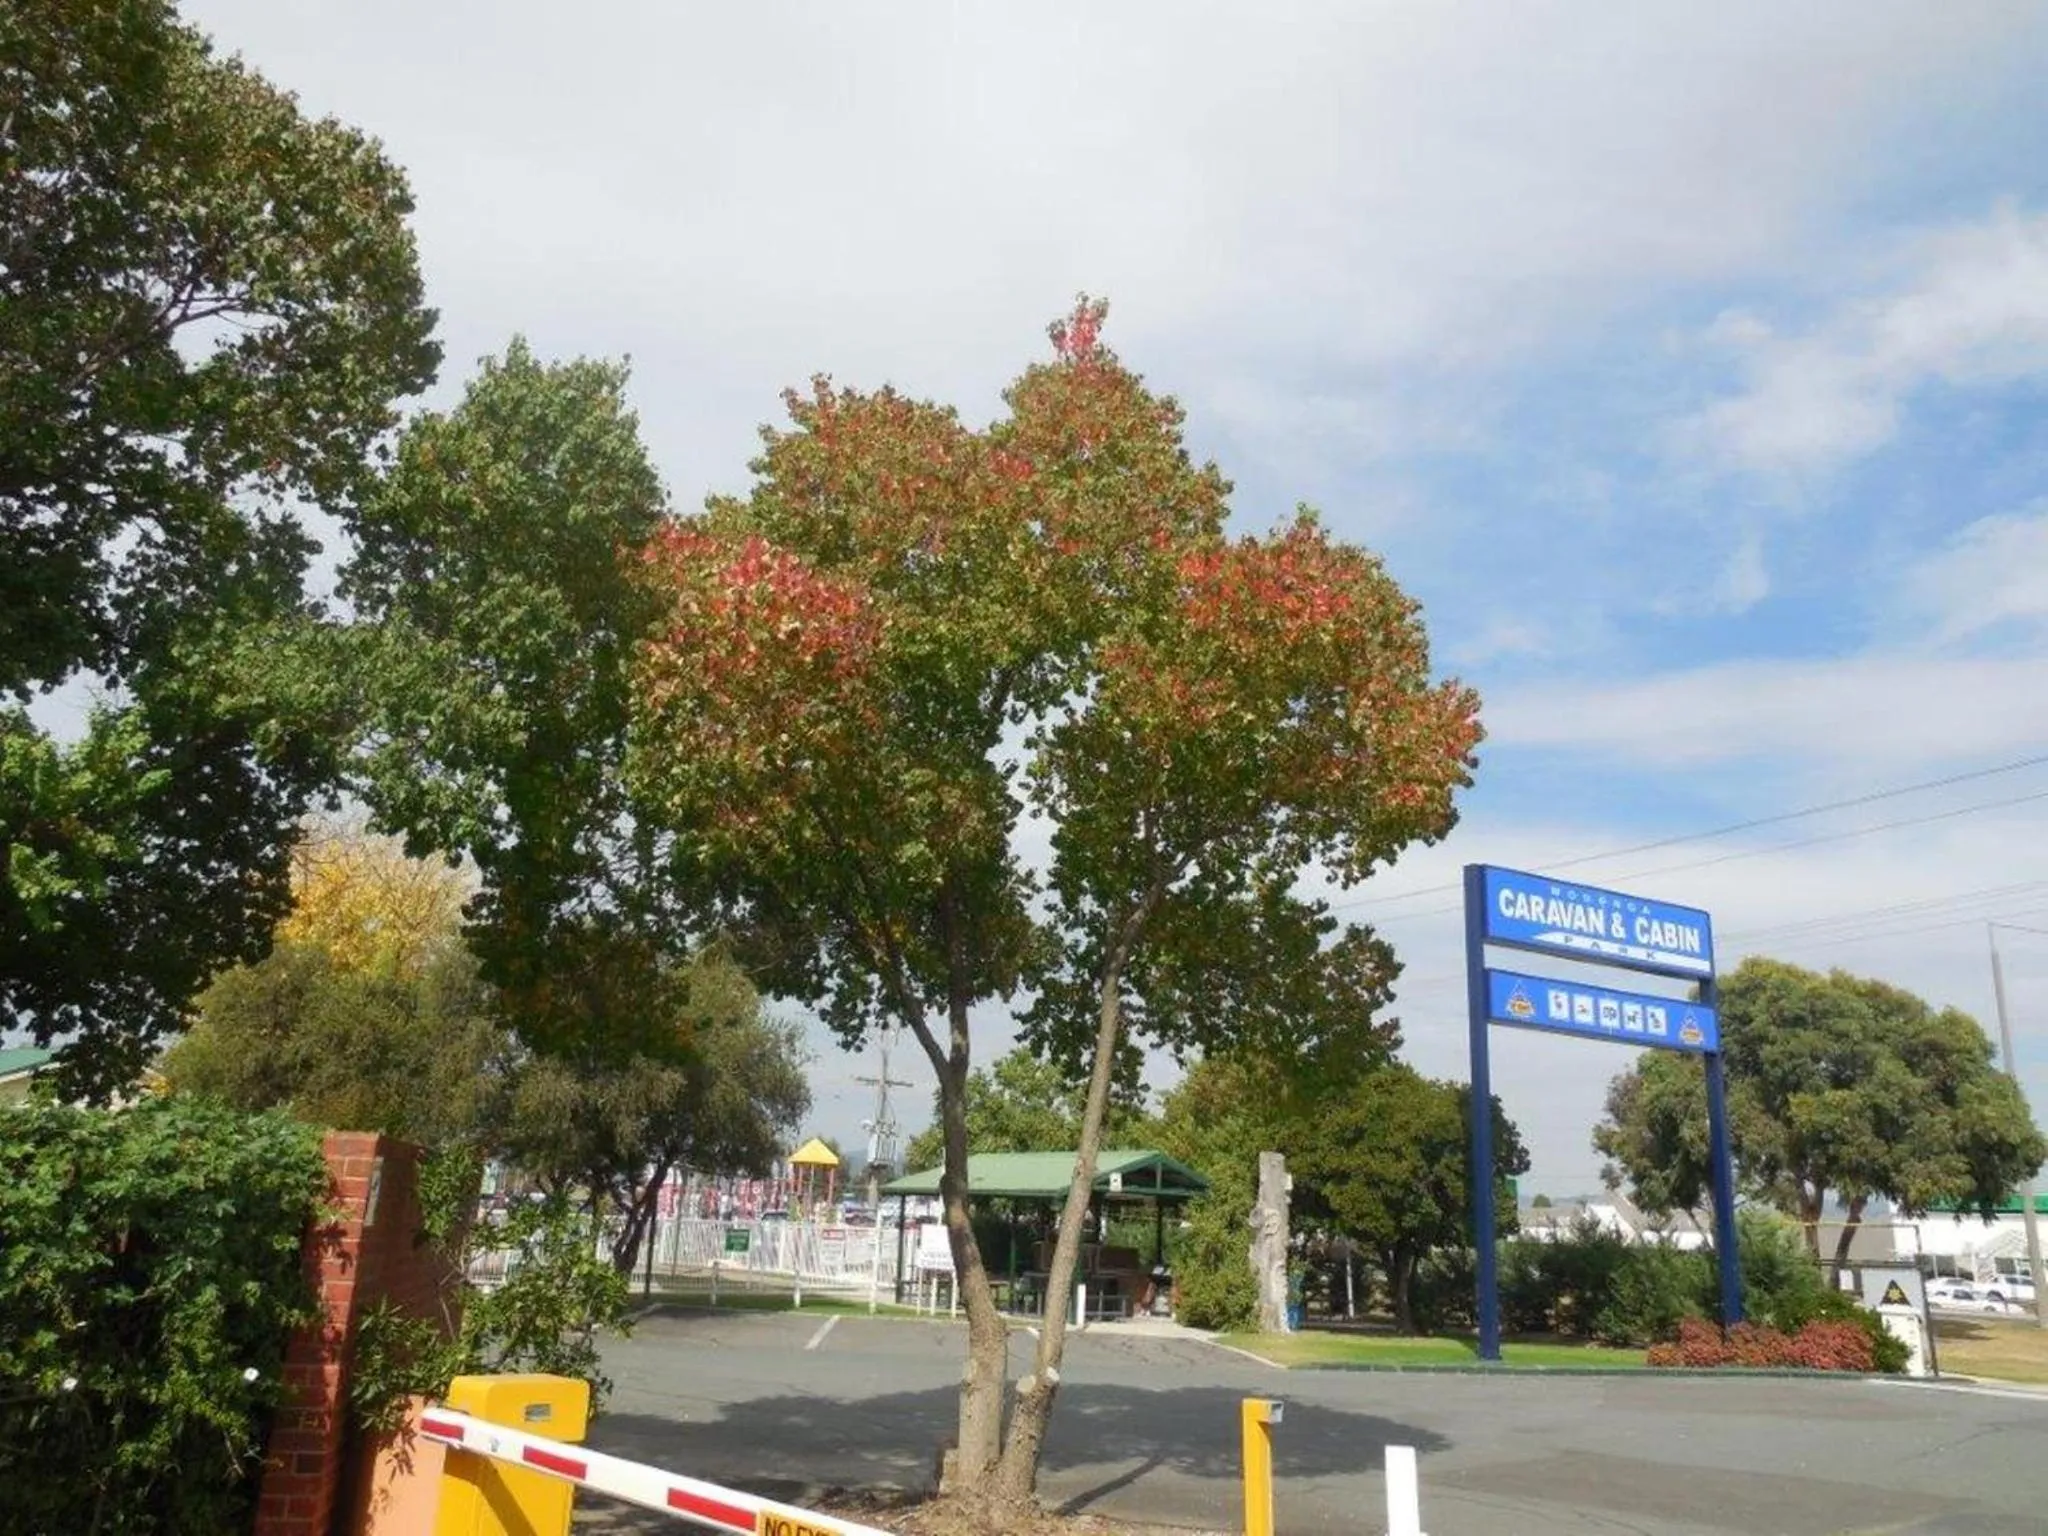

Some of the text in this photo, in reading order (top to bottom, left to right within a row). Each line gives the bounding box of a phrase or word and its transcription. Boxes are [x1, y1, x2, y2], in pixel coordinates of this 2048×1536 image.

[1499, 887, 1700, 953] CARAVAN & CABIN
